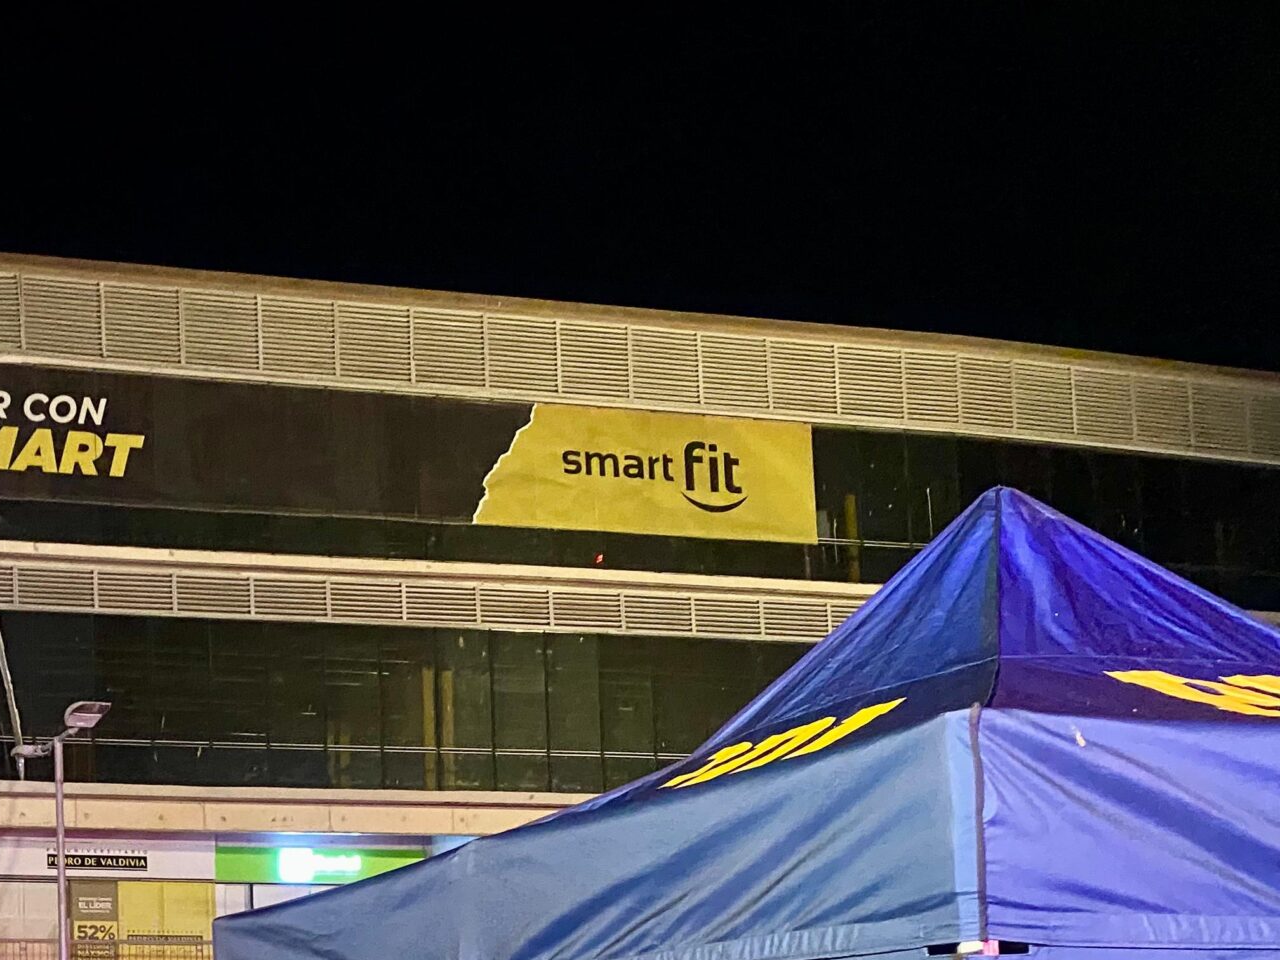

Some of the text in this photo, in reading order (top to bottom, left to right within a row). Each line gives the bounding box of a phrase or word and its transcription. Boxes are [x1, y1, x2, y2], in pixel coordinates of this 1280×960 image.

[23, 392, 107, 425] CON
[562, 441, 743, 494] smart fit
[84, 857, 97, 866] DE
[100, 858, 146, 867] VALDIVIA
[76, 924, 116, 940] 52%
